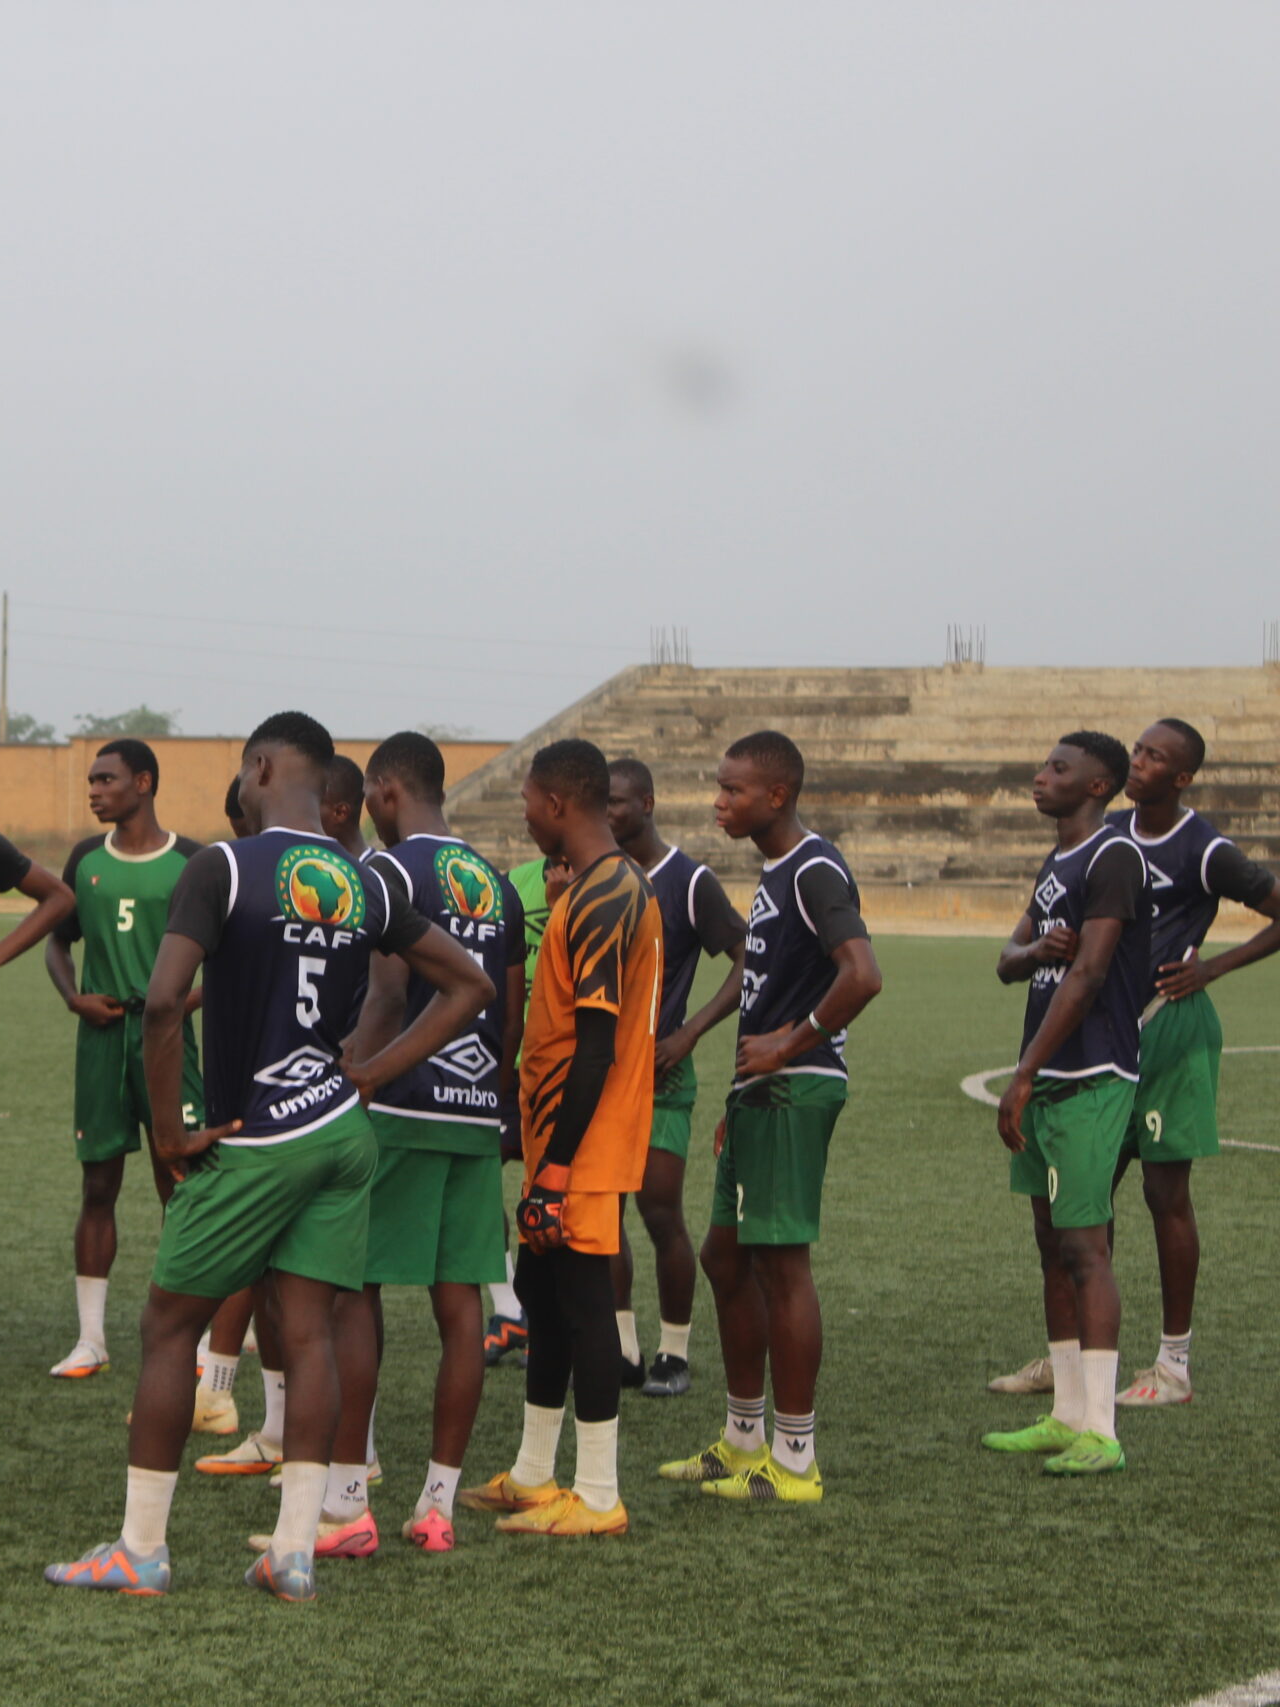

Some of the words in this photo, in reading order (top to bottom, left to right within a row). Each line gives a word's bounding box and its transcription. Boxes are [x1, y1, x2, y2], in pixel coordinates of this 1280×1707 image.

[117, 898, 135, 932] 5
[283, 923, 354, 949] CAF
[296, 955, 327, 1029] 5
[269, 1074, 343, 1120] umbro
[433, 1084, 498, 1108] umbro
[1145, 1109, 1162, 1143] 9
